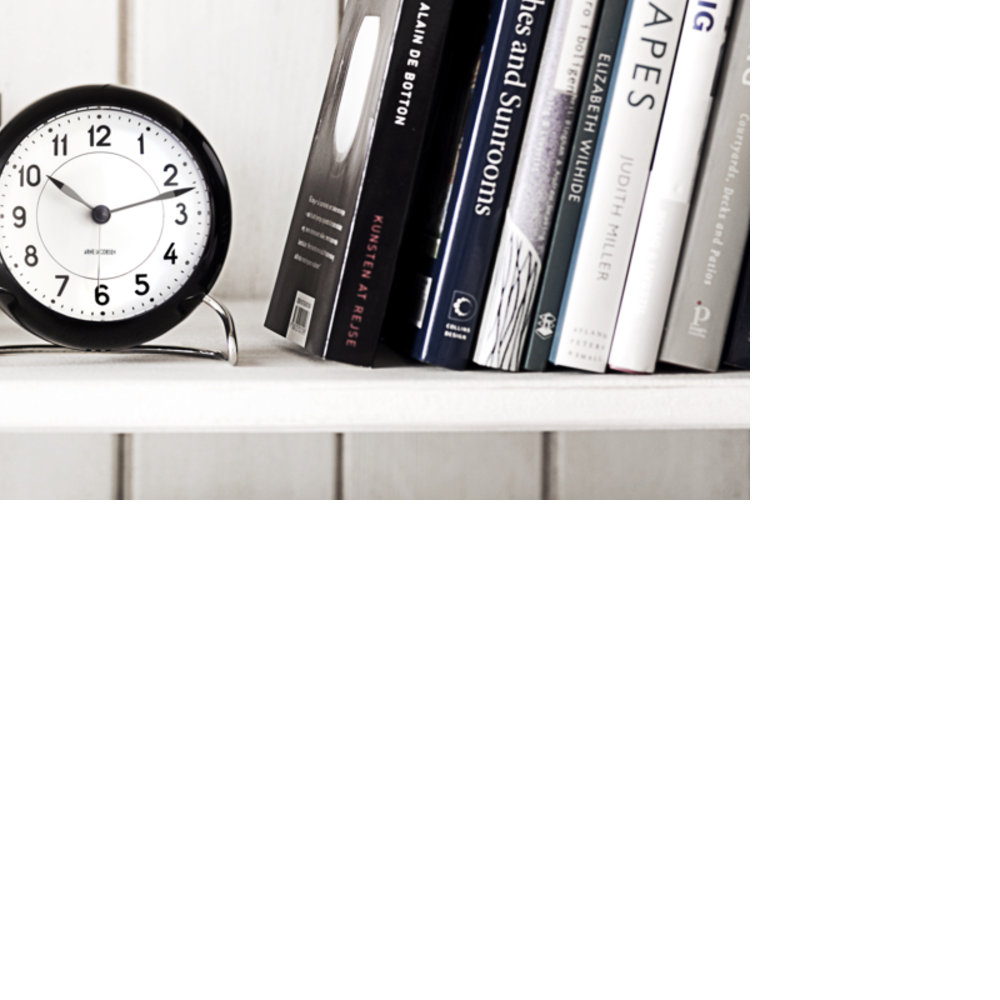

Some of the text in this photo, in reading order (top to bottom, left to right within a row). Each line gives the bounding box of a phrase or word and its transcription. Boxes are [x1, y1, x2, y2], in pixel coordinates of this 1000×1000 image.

[394, 2, 431, 126] ALAIN DE BOTTON
[503, 40, 528, 88] and
[87, 125, 112, 147] 12
[568, 52, 612, 203] ELIZABETH WILHIDE
[52, 134, 68, 156] 11
[137, 133, 145, 155] 1
[475, 92, 522, 216] Sunrooms
[18, 164, 41, 187] 10
[163, 164, 178, 186] 2
[704, 112, 750, 286] Courtyards, Decks and Patios
[12, 206, 27, 228] 9
[174, 203, 188, 225] 3
[596, 154, 635, 281] JUDITH MILLER
[24, 245, 39, 267] 8
[163, 242, 178, 265] 4
[54, 275, 70, 297] 7
[134, 273, 150, 296] 5
[345, 213, 385, 348] KUNSTEN AT REJSE
[94, 284, 110, 306] 6
[444, 330, 467, 340] DESIGN
